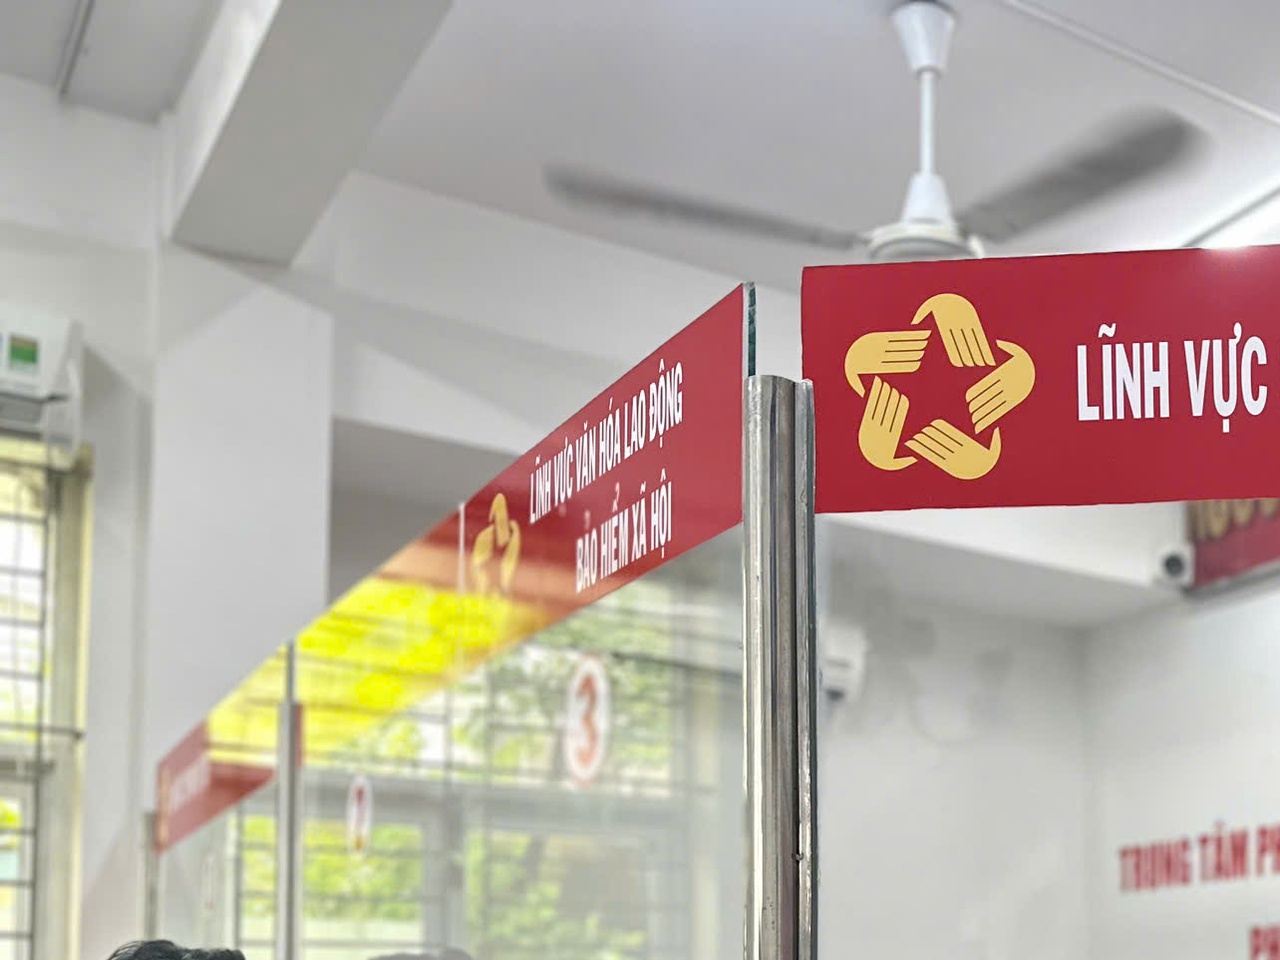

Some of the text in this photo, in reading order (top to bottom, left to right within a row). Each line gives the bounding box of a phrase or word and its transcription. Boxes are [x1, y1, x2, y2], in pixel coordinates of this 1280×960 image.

[1077, 323, 1170, 421] LĨNH
[1183, 322, 1267, 433] VỰC
[530, 358, 683, 524] LĨNH VỰC VĂN HÓA LAO ĐỘNG
[576, 467, 672, 594] BẢO HIỂM XÃ HỘI
[1198, 819, 1248, 883] TÂM
